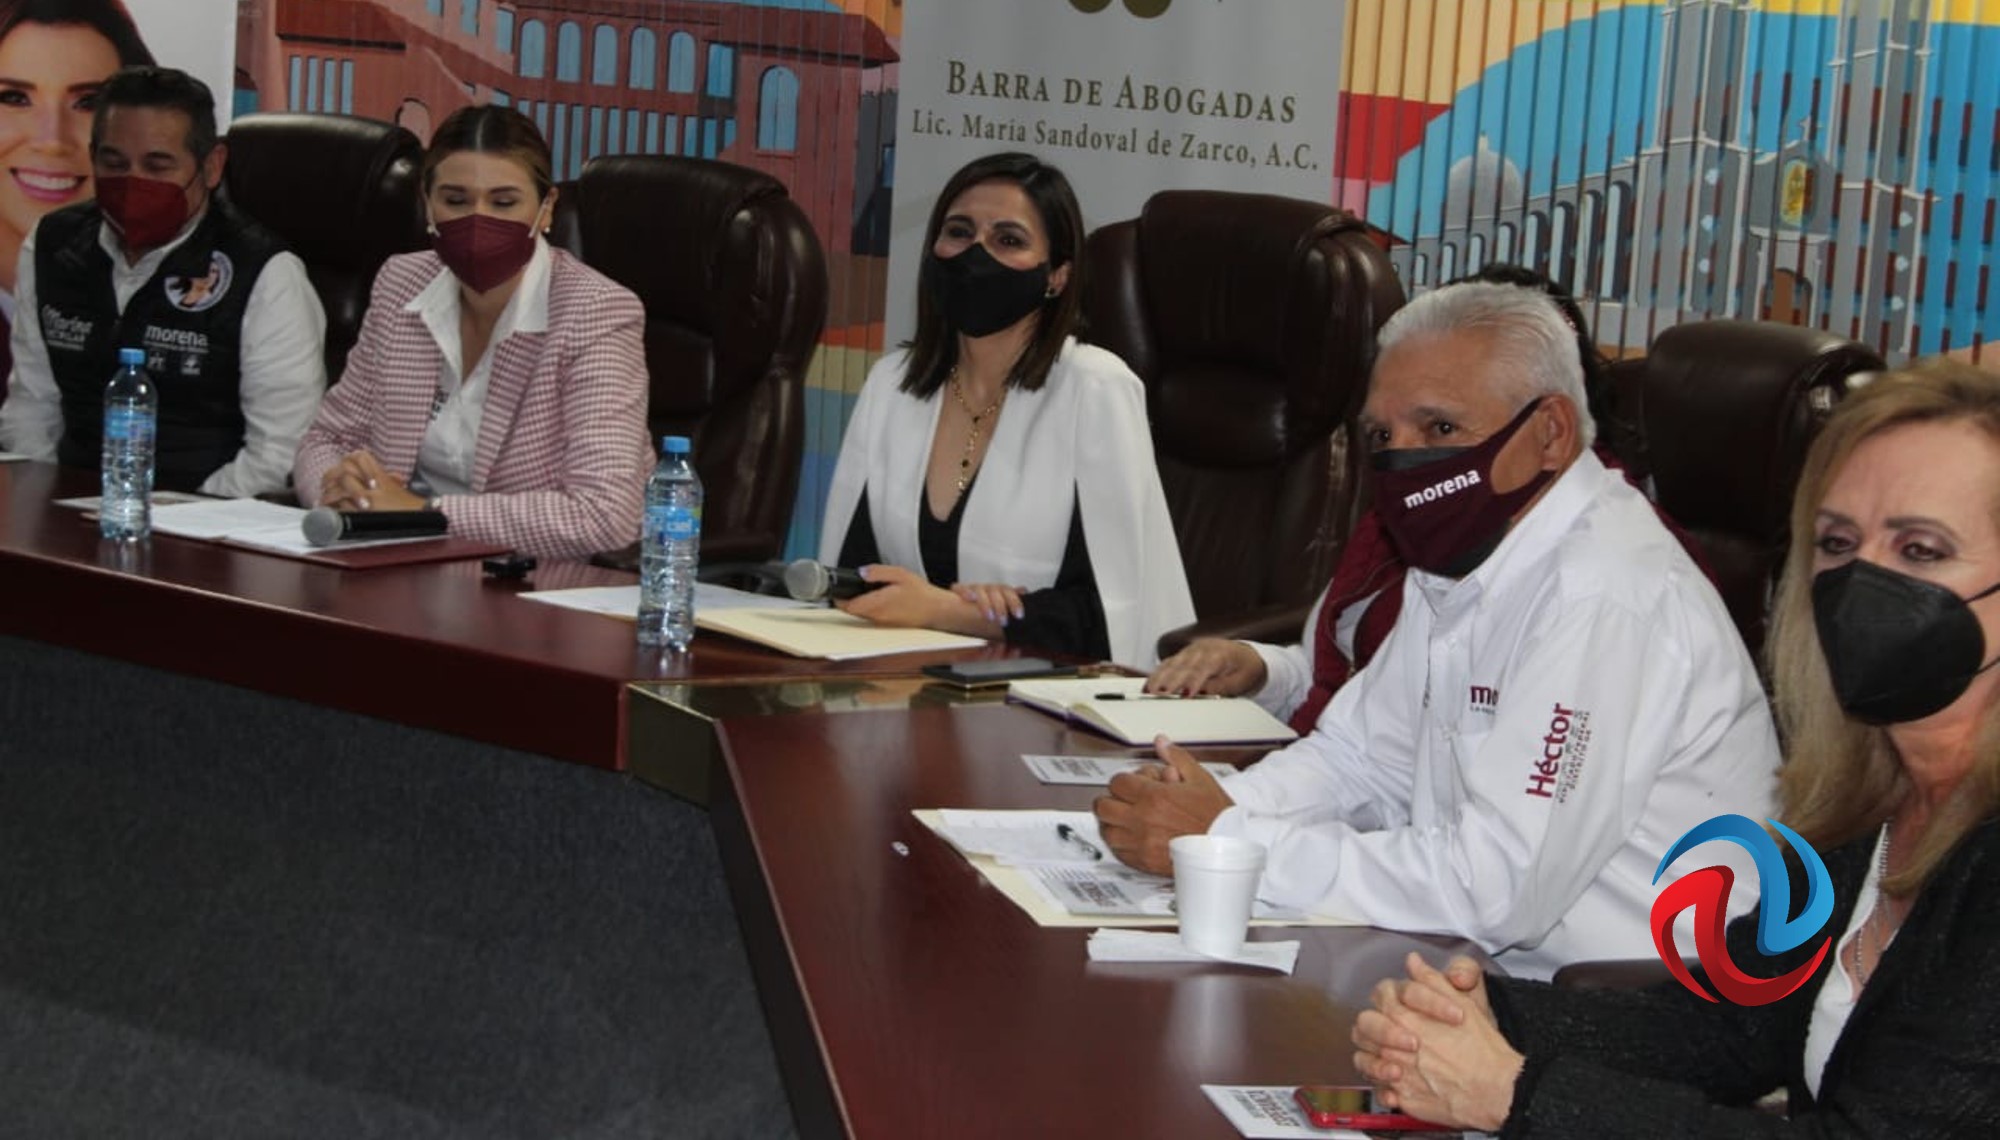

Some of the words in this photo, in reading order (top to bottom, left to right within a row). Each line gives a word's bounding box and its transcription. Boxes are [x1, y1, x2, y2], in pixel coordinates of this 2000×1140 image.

[946, 60, 1050, 102] BARRA
[1063, 78, 1103, 107] DE
[1114, 75, 1297, 124] ABOGADAS
[912, 110, 952, 137] Lic.
[961, 114, 1027, 142] María
[1034, 120, 1137, 154] Sandoval
[1147, 129, 1172, 156] de
[1181, 134, 1257, 168] Zarco,
[1265, 142, 1319, 171] A.C.
[145, 325, 208, 347] morena
[1404, 469, 1481, 510] morena
[1525, 702, 1574, 798] Héctor
